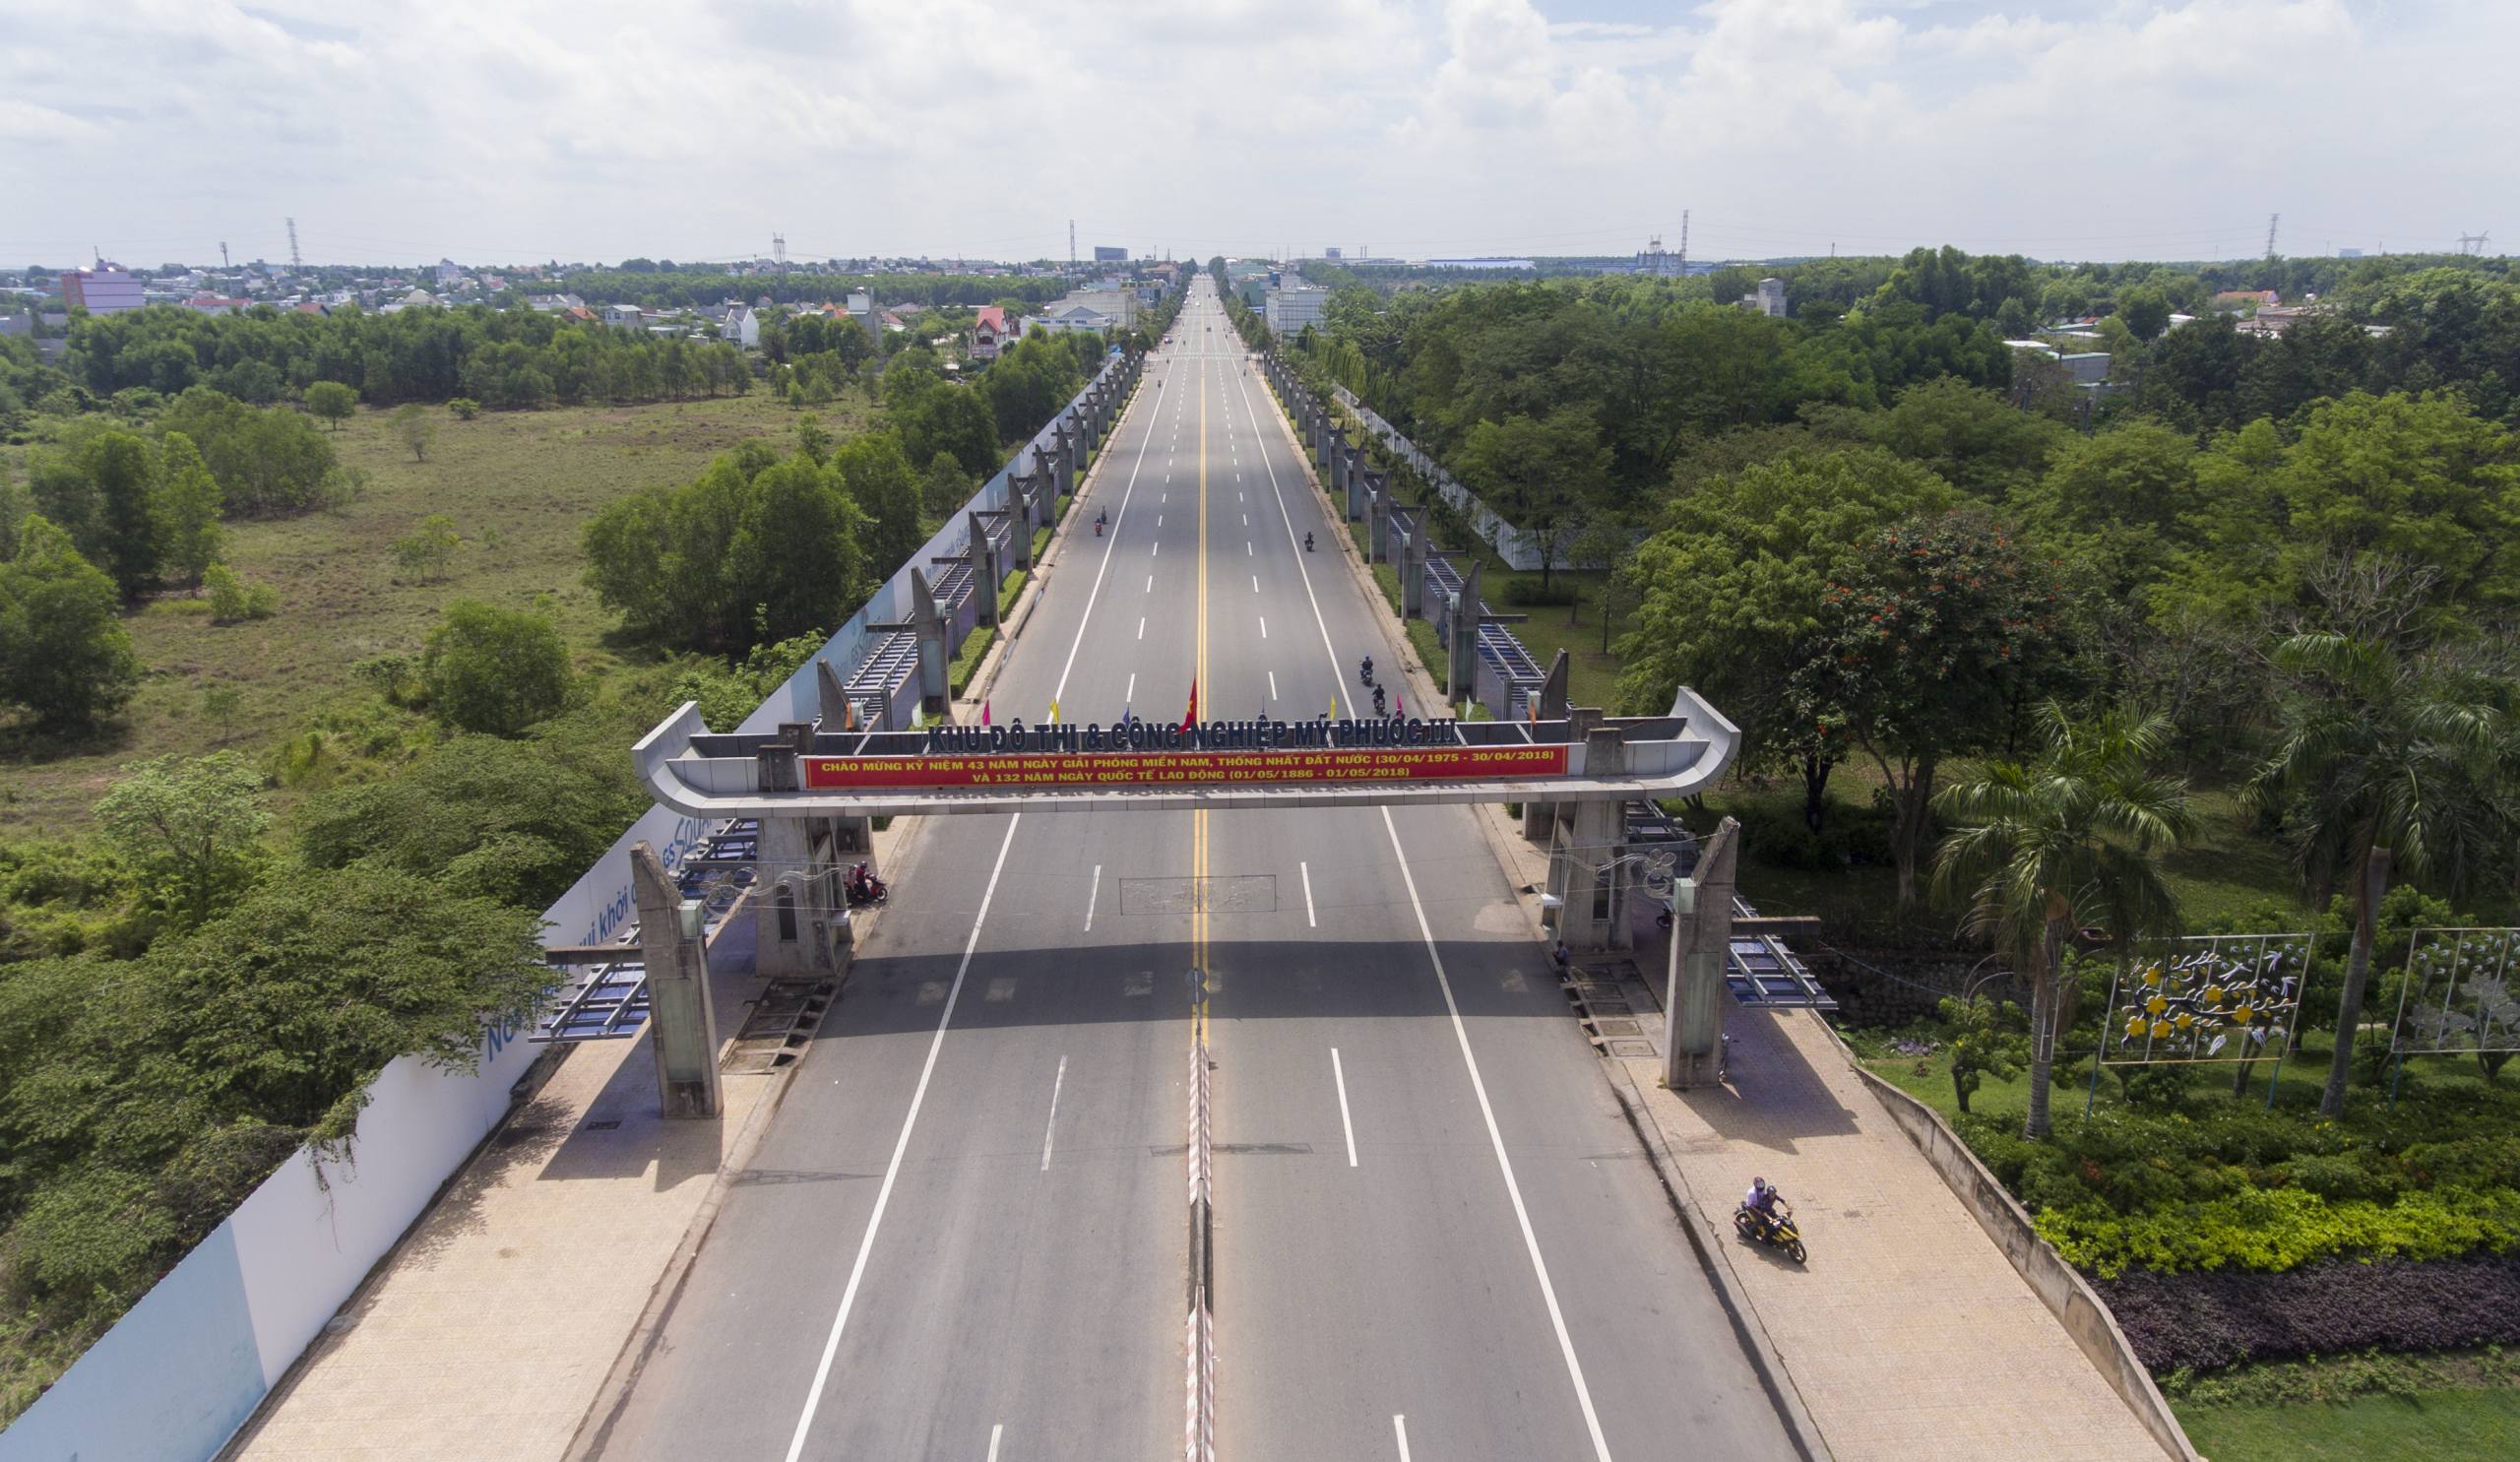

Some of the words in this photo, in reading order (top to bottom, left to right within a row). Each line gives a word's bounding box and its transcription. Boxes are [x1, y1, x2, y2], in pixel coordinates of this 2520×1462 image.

[928, 725, 980, 751] KHU
[989, 718, 1026, 751] ĐÔ
[1087, 723, 1103, 749] &
[1110, 717, 1181, 748] CÔNG
[1190, 714, 1288, 751] NGHIỆP
[1294, 713, 1332, 746] MỸ
[1428, 718, 1457, 743] III
[822, 760, 858, 772] CHÀO
[862, 760, 903, 772] MỪNG
[929, 759, 964, 772] NIỆM
[968, 760, 984, 770] 43
[988, 758, 1019, 769] NĂM
[1024, 758, 1057, 769] NGÀY
[1094, 755, 1139, 768] PHÓNG
[1181, 757, 1214, 767] NAM,
[1217, 754, 1262, 766] THỐNG
[1266, 754, 1301, 765] NHẤT
[1305, 753, 1332, 765] ĐẤT
[1336, 753, 1371, 764] NƯỚC
[1376, 753, 1459, 765] (30/04/1975
[1472, 750, 1554, 762] 30/04/2018)
[973, 772, 990, 783] VÀ
[995, 773, 1021, 782] 132
[1025, 772, 1054, 782] NĂM
[1058, 771, 1093, 782] NGÀY
[1098, 769, 1134, 781] QUỐC
[1138, 768, 1156, 780] TẾ
[1159, 771, 1184, 780] LAO
[1189, 769, 1226, 781] ĐỘNG
[1229, 769, 1314, 780] (01/05/1886
[1326, 767, 1410, 779] 01/05/2018)
